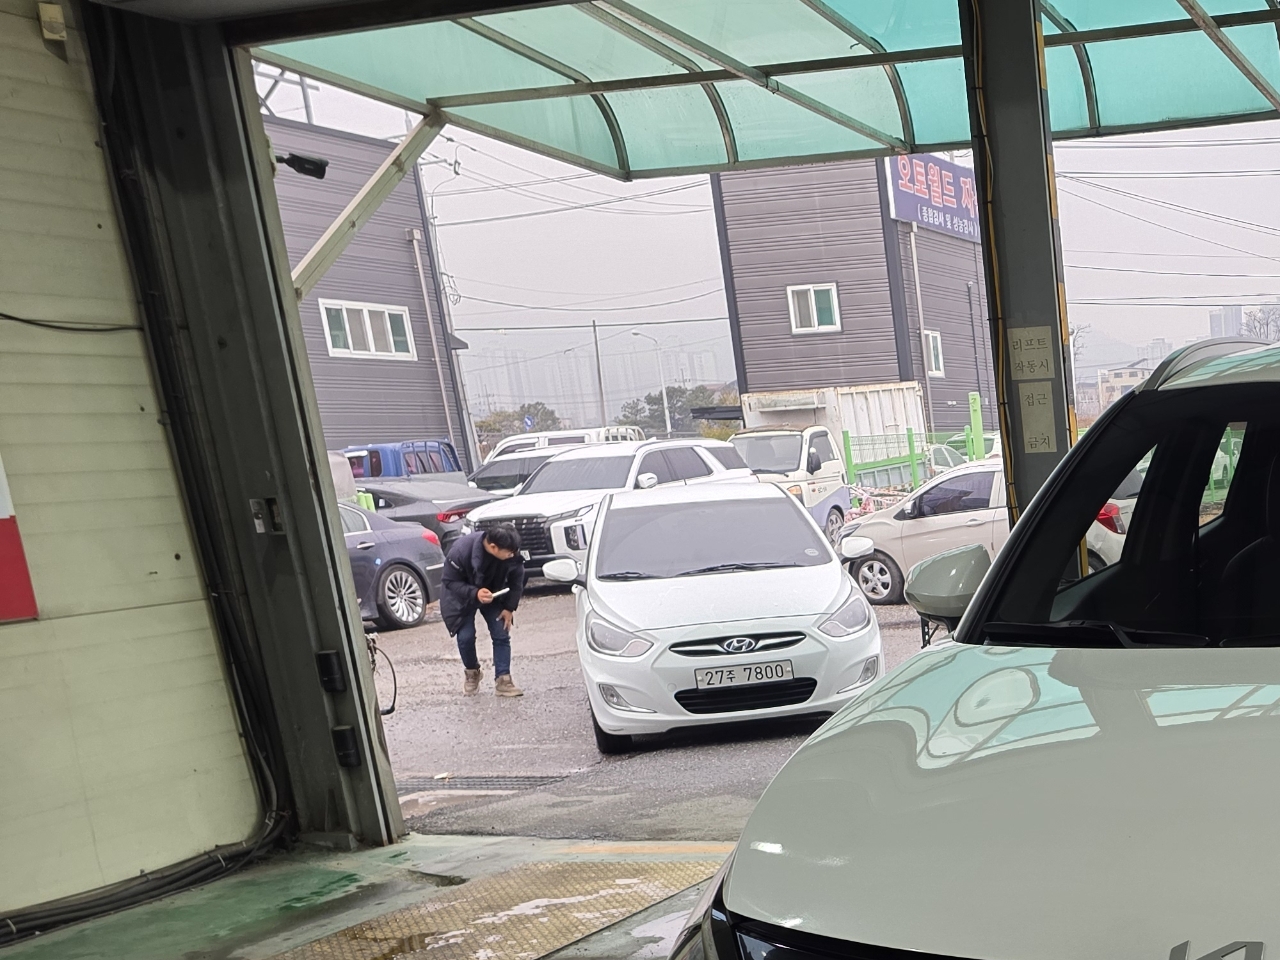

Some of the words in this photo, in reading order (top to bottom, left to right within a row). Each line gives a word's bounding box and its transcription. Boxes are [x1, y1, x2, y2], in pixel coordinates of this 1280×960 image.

[898, 154, 957, 208] 오토월드
[960, 177, 979, 218] 자
[1011, 337, 1049, 352] 리프트
[1014, 358, 1050, 374] 작동시
[1024, 392, 1048, 407] 접근
[1027, 435, 1051, 449] 금지
[704, 670, 736, 686] 27주
[743, 664, 784, 681] 7800
